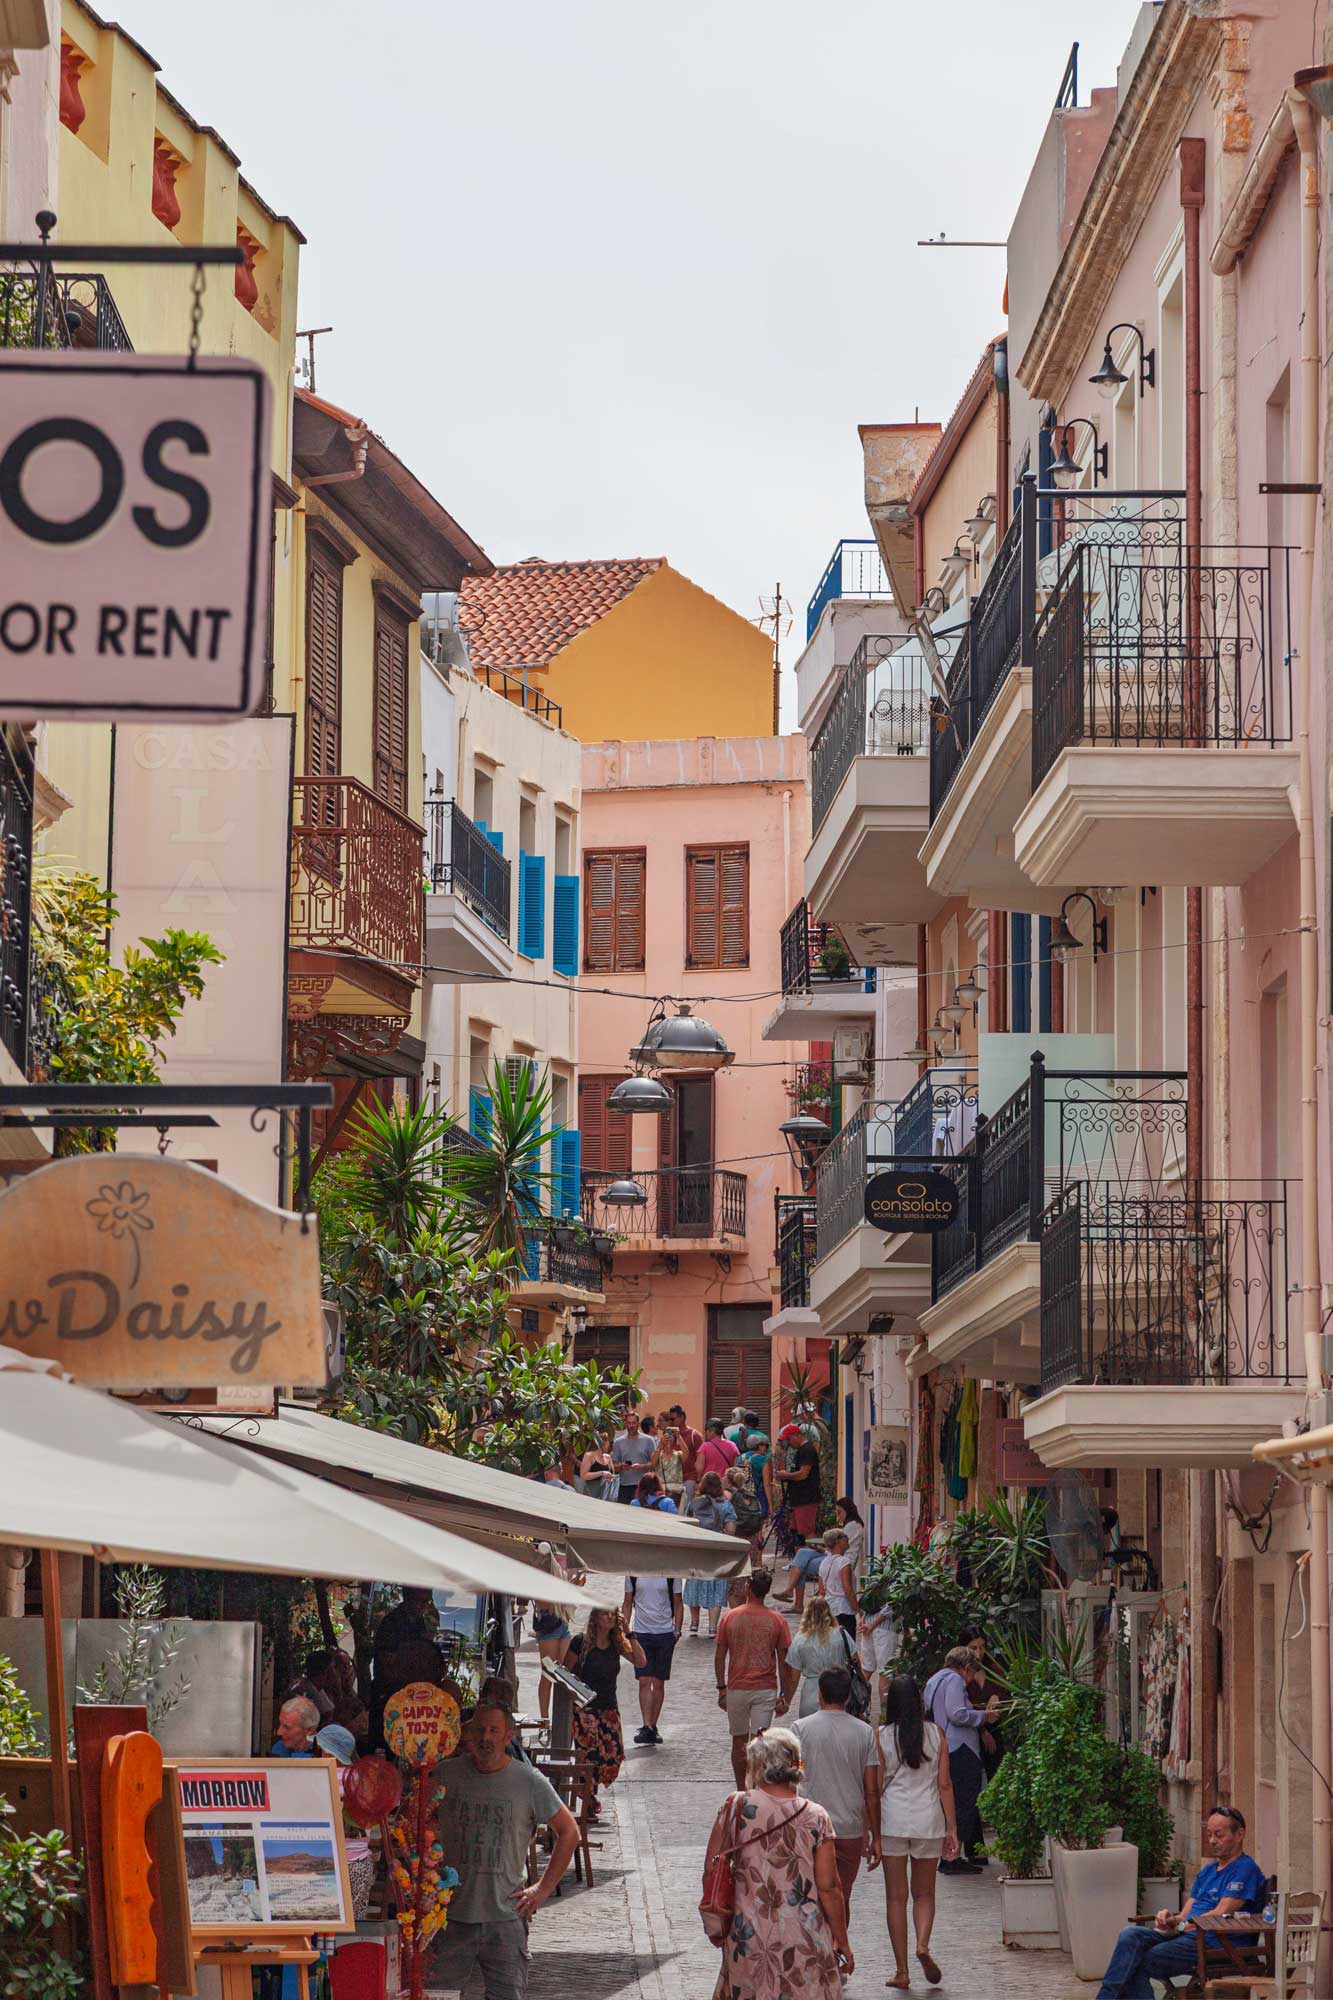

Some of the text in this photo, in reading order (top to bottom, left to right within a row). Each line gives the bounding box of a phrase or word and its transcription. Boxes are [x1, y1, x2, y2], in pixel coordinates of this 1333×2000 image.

[97, 605, 232, 662] RENT
[133, 730, 274, 771] CASA
[871, 1198, 953, 1213] consolato
[402, 1705, 443, 1719] CANDY
[406, 1721, 439, 1735] TOYS
[180, 1779, 266, 1808] MORROW
